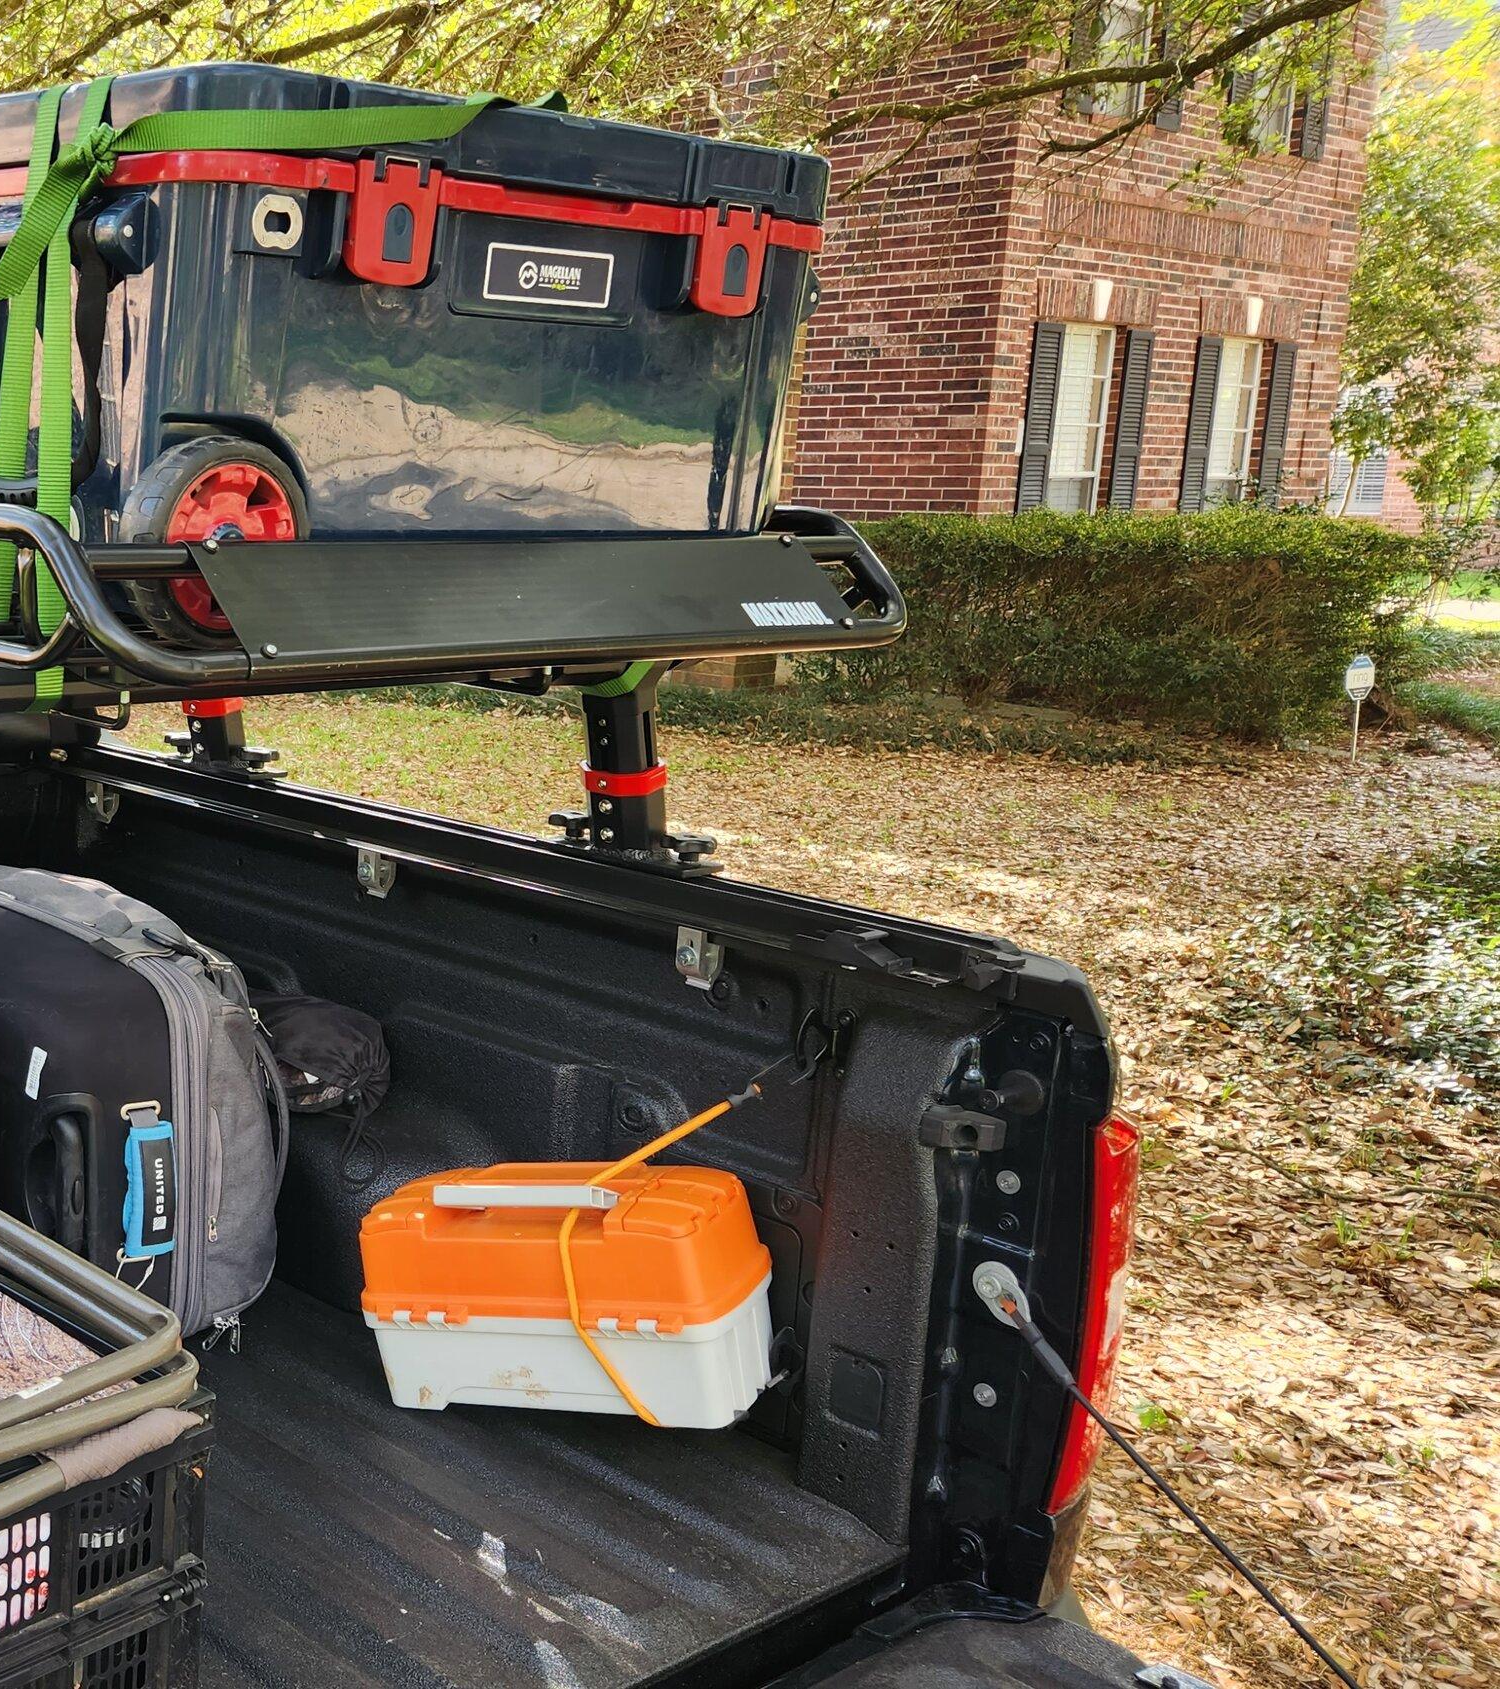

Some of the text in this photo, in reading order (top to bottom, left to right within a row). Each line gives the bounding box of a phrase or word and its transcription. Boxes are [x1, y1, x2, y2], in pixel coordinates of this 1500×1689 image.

[539, 264, 582, 280] MAGELLAN
[740, 601, 835, 627] MAXXHAUL
[154, 1158, 166, 1215] UNITED
